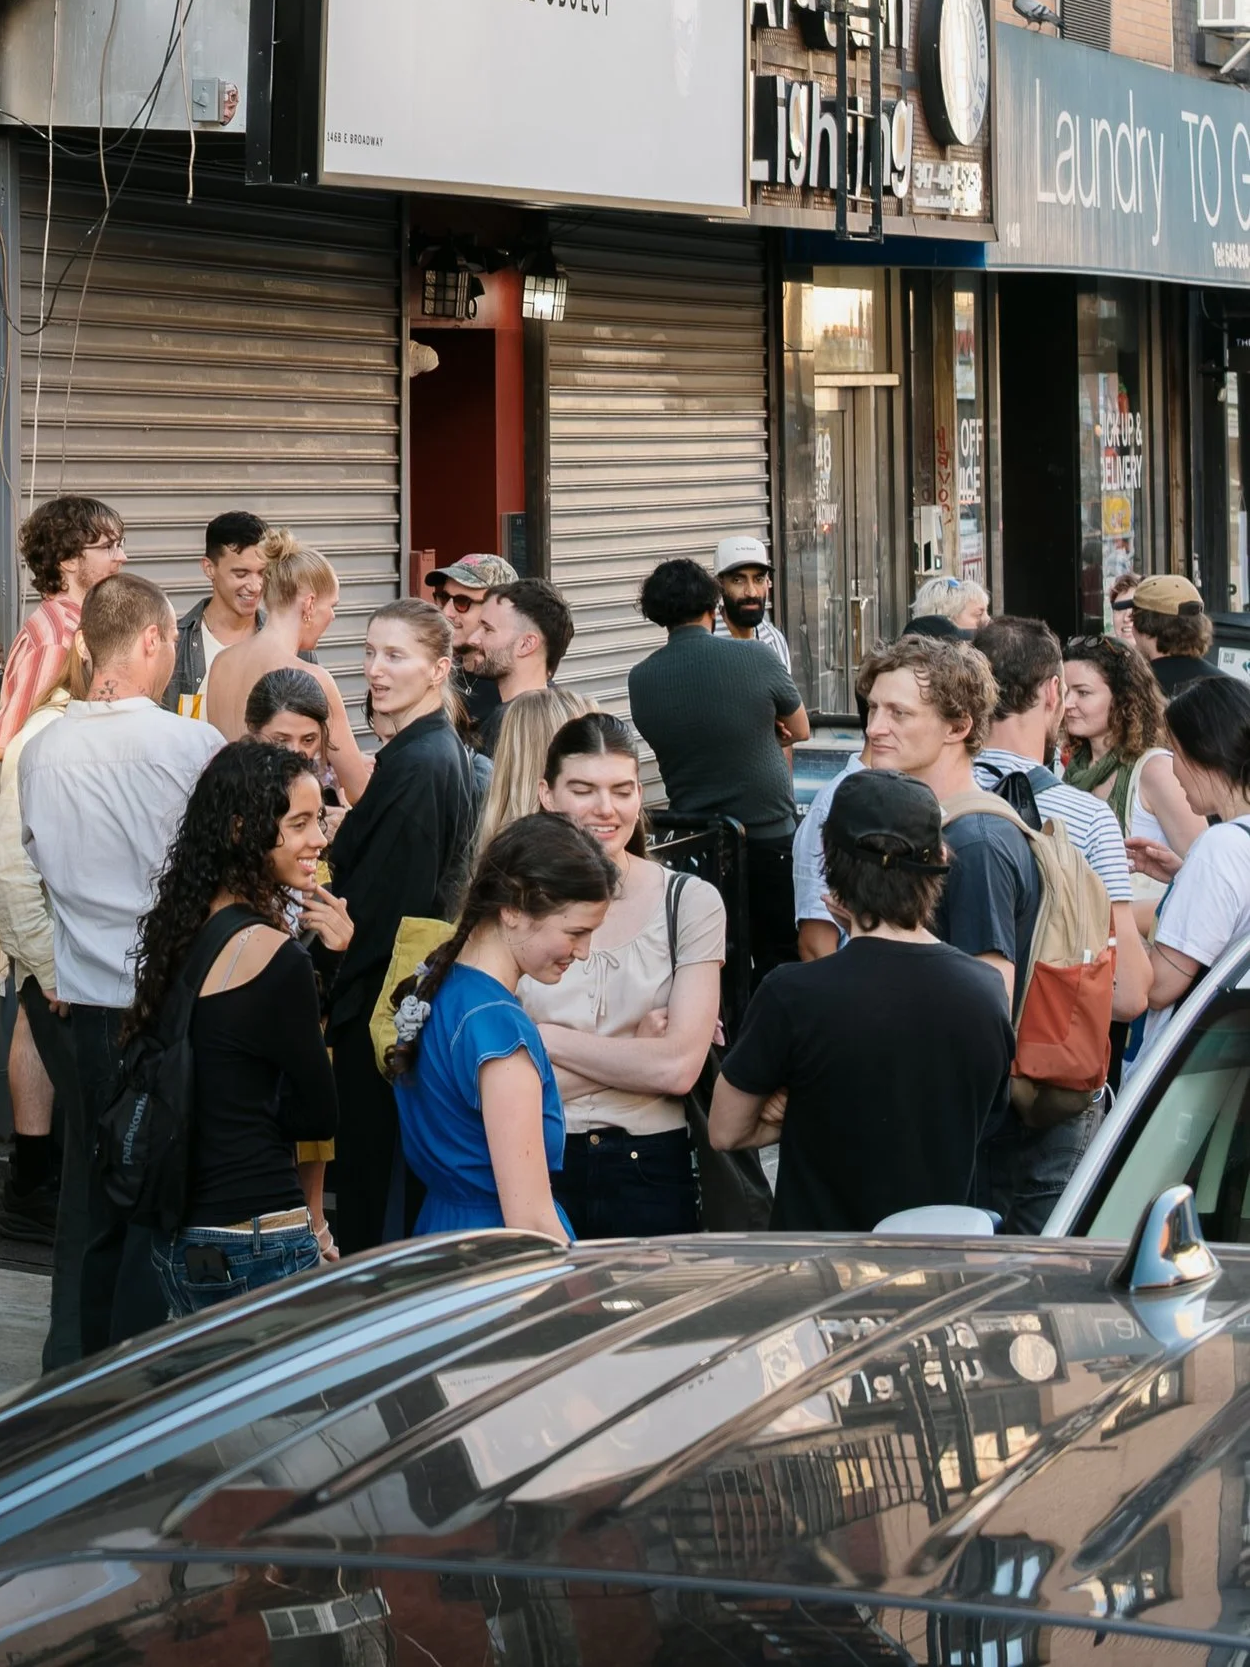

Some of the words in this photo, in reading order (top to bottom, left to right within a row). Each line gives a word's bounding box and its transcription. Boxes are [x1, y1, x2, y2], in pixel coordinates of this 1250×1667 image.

[327, 131, 341, 143] 146B
[344, 133, 348, 144] E
[350, 133, 384, 147] BROADWAY
[1035, 77, 1164, 247] Laundry
[1181, 110, 1221, 227] TO
[1231, 121, 1250, 232] G
[961, 418, 984, 458] OFF
[1121, 412, 1134, 447] UP
[1135, 412, 1143, 447] &
[1101, 454, 1143, 491] DELIVERY
